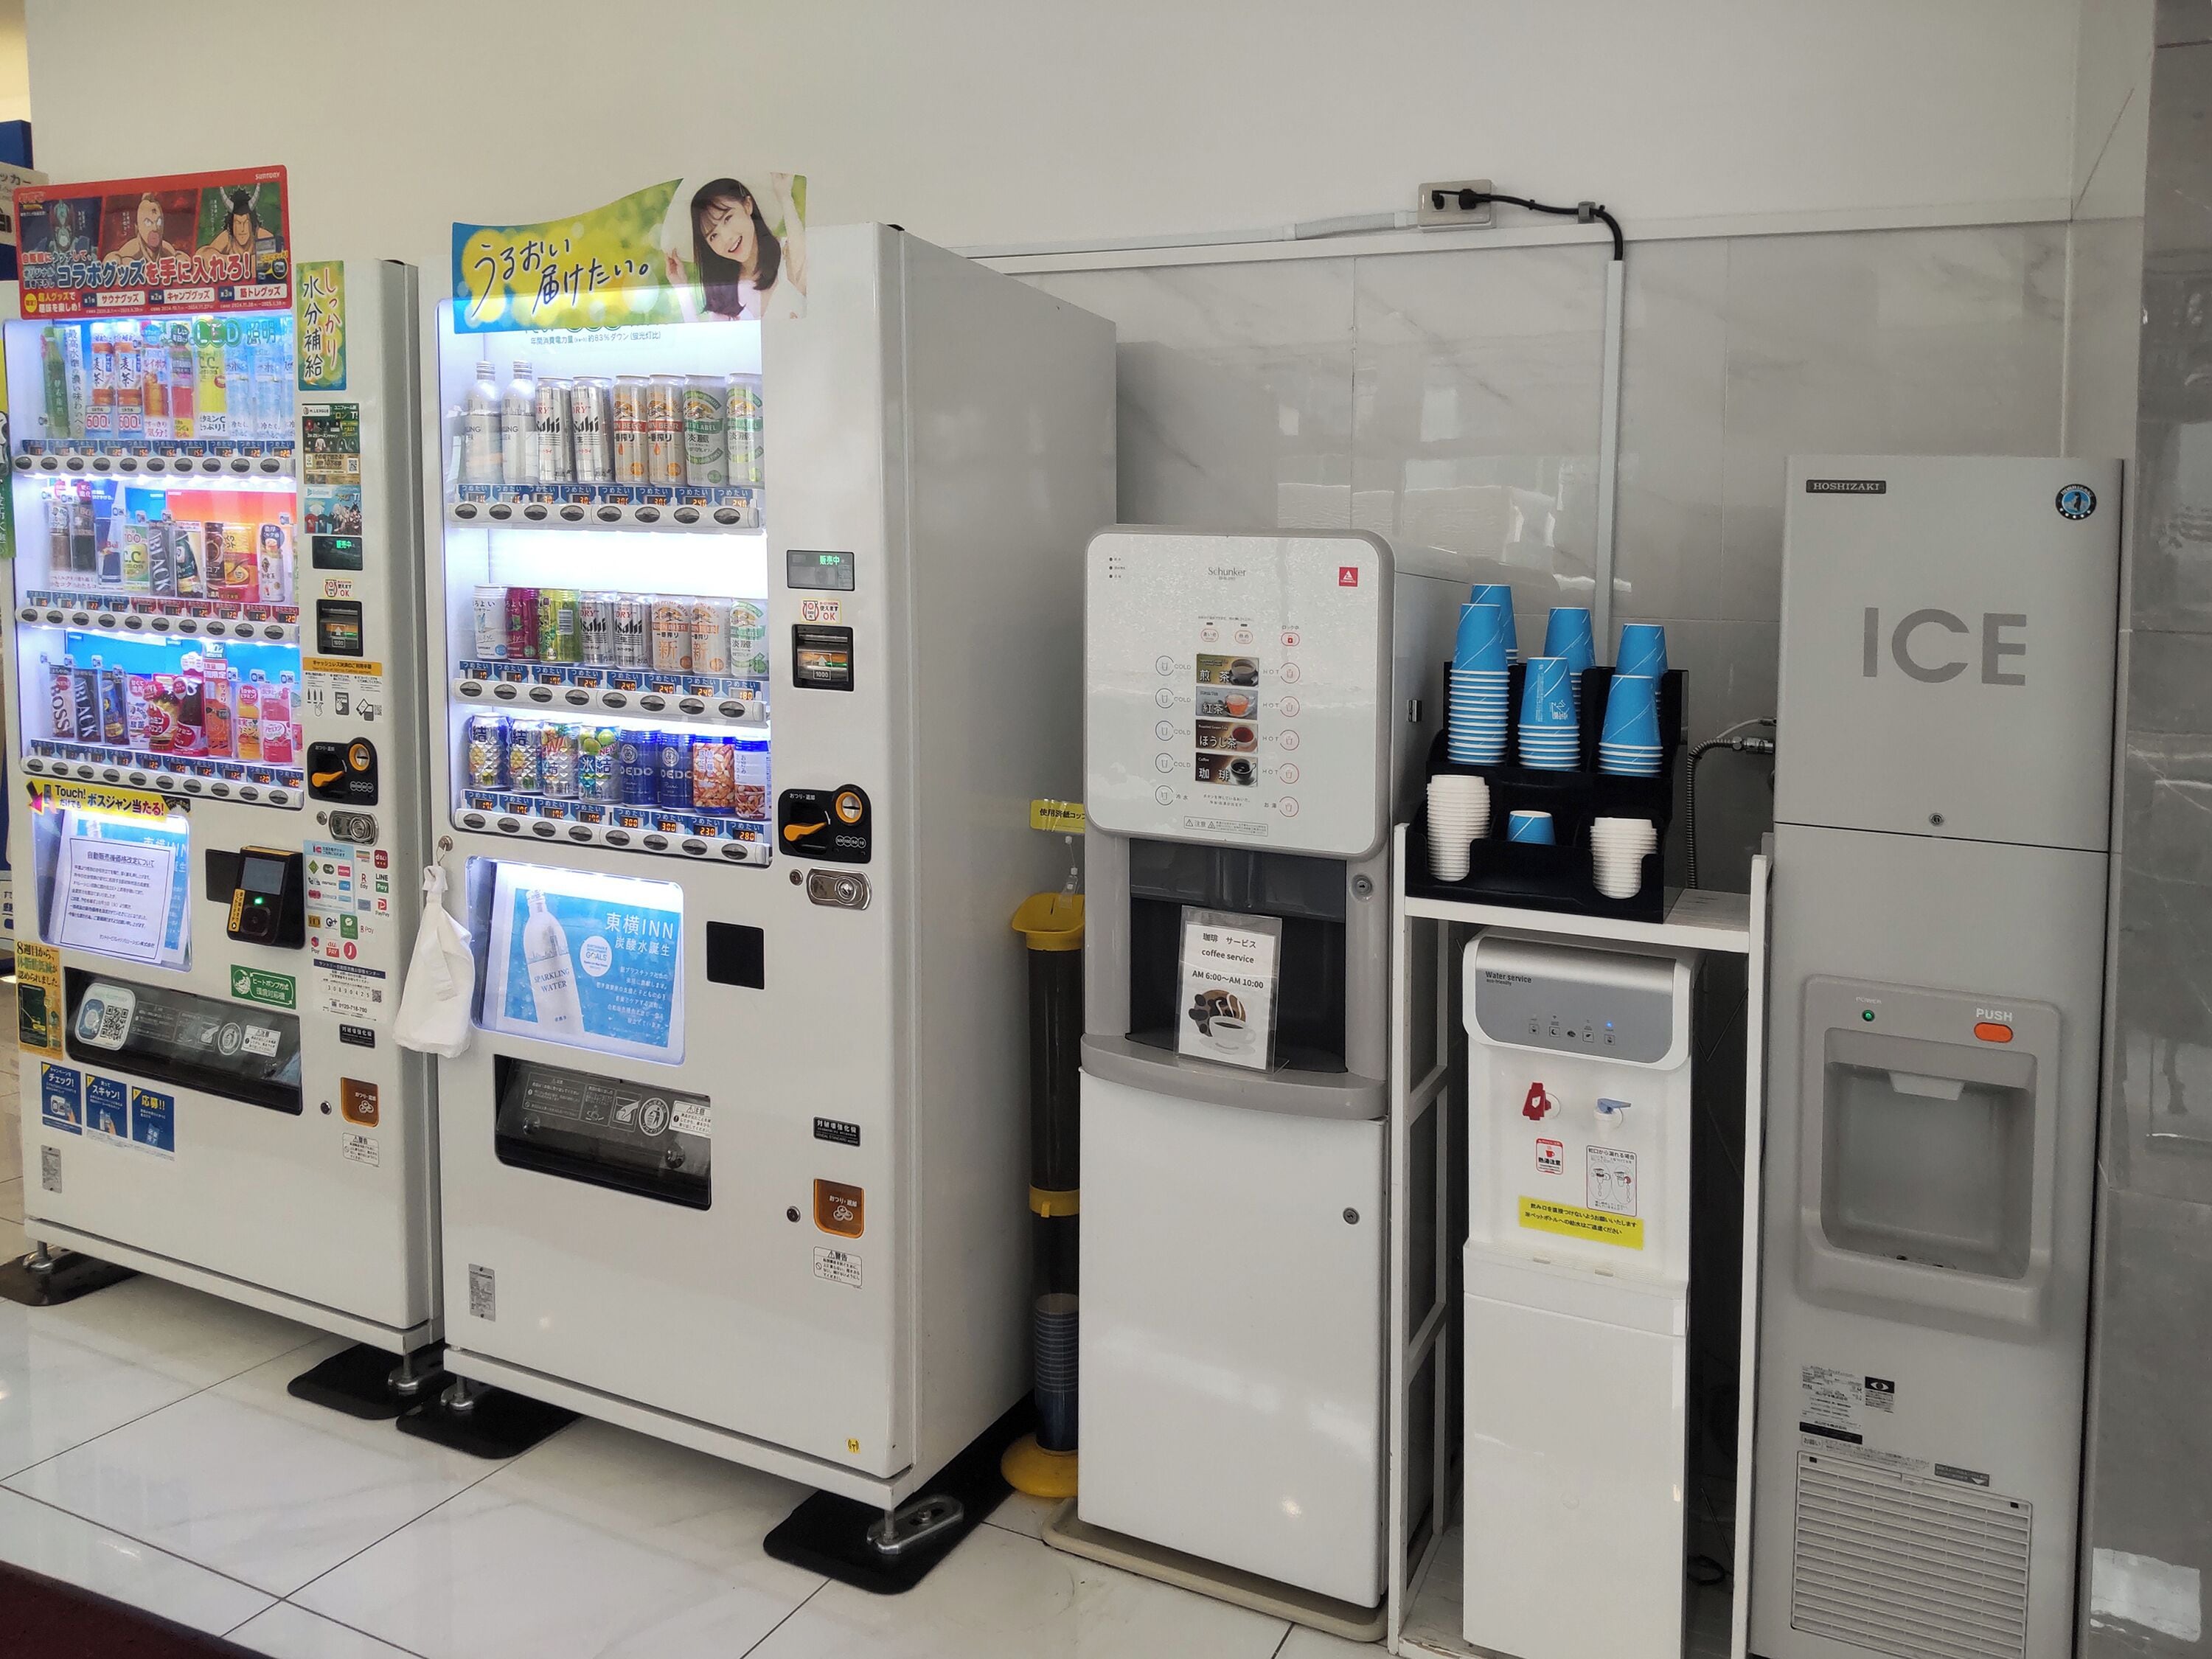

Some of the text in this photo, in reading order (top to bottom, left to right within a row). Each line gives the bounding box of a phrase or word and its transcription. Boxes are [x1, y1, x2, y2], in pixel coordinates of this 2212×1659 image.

[470, 238, 571, 320] うるおい
[531, 260, 649, 316] 届けたい。
[102, 293, 140, 304] サウナグッズ
[167, 290, 211, 302] キャンプグッズ
[323, 268, 337, 370] しっかり
[302, 274, 324, 380] 水分補給
[695, 422, 717, 432] LABEL
[688, 434, 709, 443] 淡麗
[640, 487, 668, 495] つめたい
[679, 487, 709, 496] つめたい
[1812, 481, 1880, 492] HOSHIZAKI
[717, 489, 748, 497] つめたい
[732, 498, 748, 507] 240
[819, 555, 841, 566] 販売中
[1208, 566, 1247, 577] Schunker
[340, 589, 350, 597] OK
[616, 610, 633, 619] DRY
[823, 612, 836, 621] OK
[658, 639, 678, 661] 新
[693, 640, 709, 661] 新
[1863, 607, 2027, 686] ICE
[497, 664, 524, 672] つめたい
[535, 666, 563, 675] つめたい
[571, 669, 599, 677] つめたい
[611, 672, 639, 680] つめたい
[648, 674, 677, 683] つめたい
[621, 682, 636, 691] 240
[686, 677, 717, 686] つめたい
[726, 680, 756, 688] つめたい
[658, 686, 674, 695] 240
[698, 689, 713, 698] 240
[1202, 703, 1224, 715] 紅茶
[1199, 736, 1238, 750] ほうじ茶
[582, 756, 612, 774] 氷結
[55, 785, 86, 799] Touch!
[60, 799, 82, 809] だけでも
[88, 793, 164, 816] ボスジャン当たる!
[503, 796, 529, 804] つめたい
[538, 799, 565, 808] つめたい
[574, 804, 602, 813] つめたい
[617, 809, 646, 818] つめたい
[624, 818, 639, 827] 300
[655, 813, 684, 822] つめたい
[692, 817, 720, 827] つめたい
[661, 822, 676, 832] 300
[700, 827, 715, 835] 230
[731, 821, 760, 831] つめたい
[739, 831, 755, 841] 280
[361, 873, 367, 883] R
[605, 912, 674, 940] 東横INN
[1203, 932, 1257, 949] 珈琲 サービス
[16, 941, 56, 961] 8週目から、
[615, 936, 671, 957] 炭酸水誕生
[1201, 949, 1255, 964] coffee service
[534, 967, 571, 984] SPARKLING
[1192, 970, 1204, 978] AM
[1242, 978, 1264, 989] 10:00
[1485, 970, 1532, 984] Water service
[540, 979, 567, 993] WATER
[1855, 995, 1882, 1006] POWER
[1975, 1007, 2014, 1023] PUSH
[49, 1072, 74, 1088] チェック!
[93, 1085, 120, 1100] スキャン!
[141, 1095, 166, 1111] 応募!!
[1588, 1147, 1635, 1161] 蛇口から漏れる場合
[1538, 1157, 1562, 1166] 熱湯注意
[1530, 1203, 1638, 1228] 飲み口を直接つけないようお願いいたします
